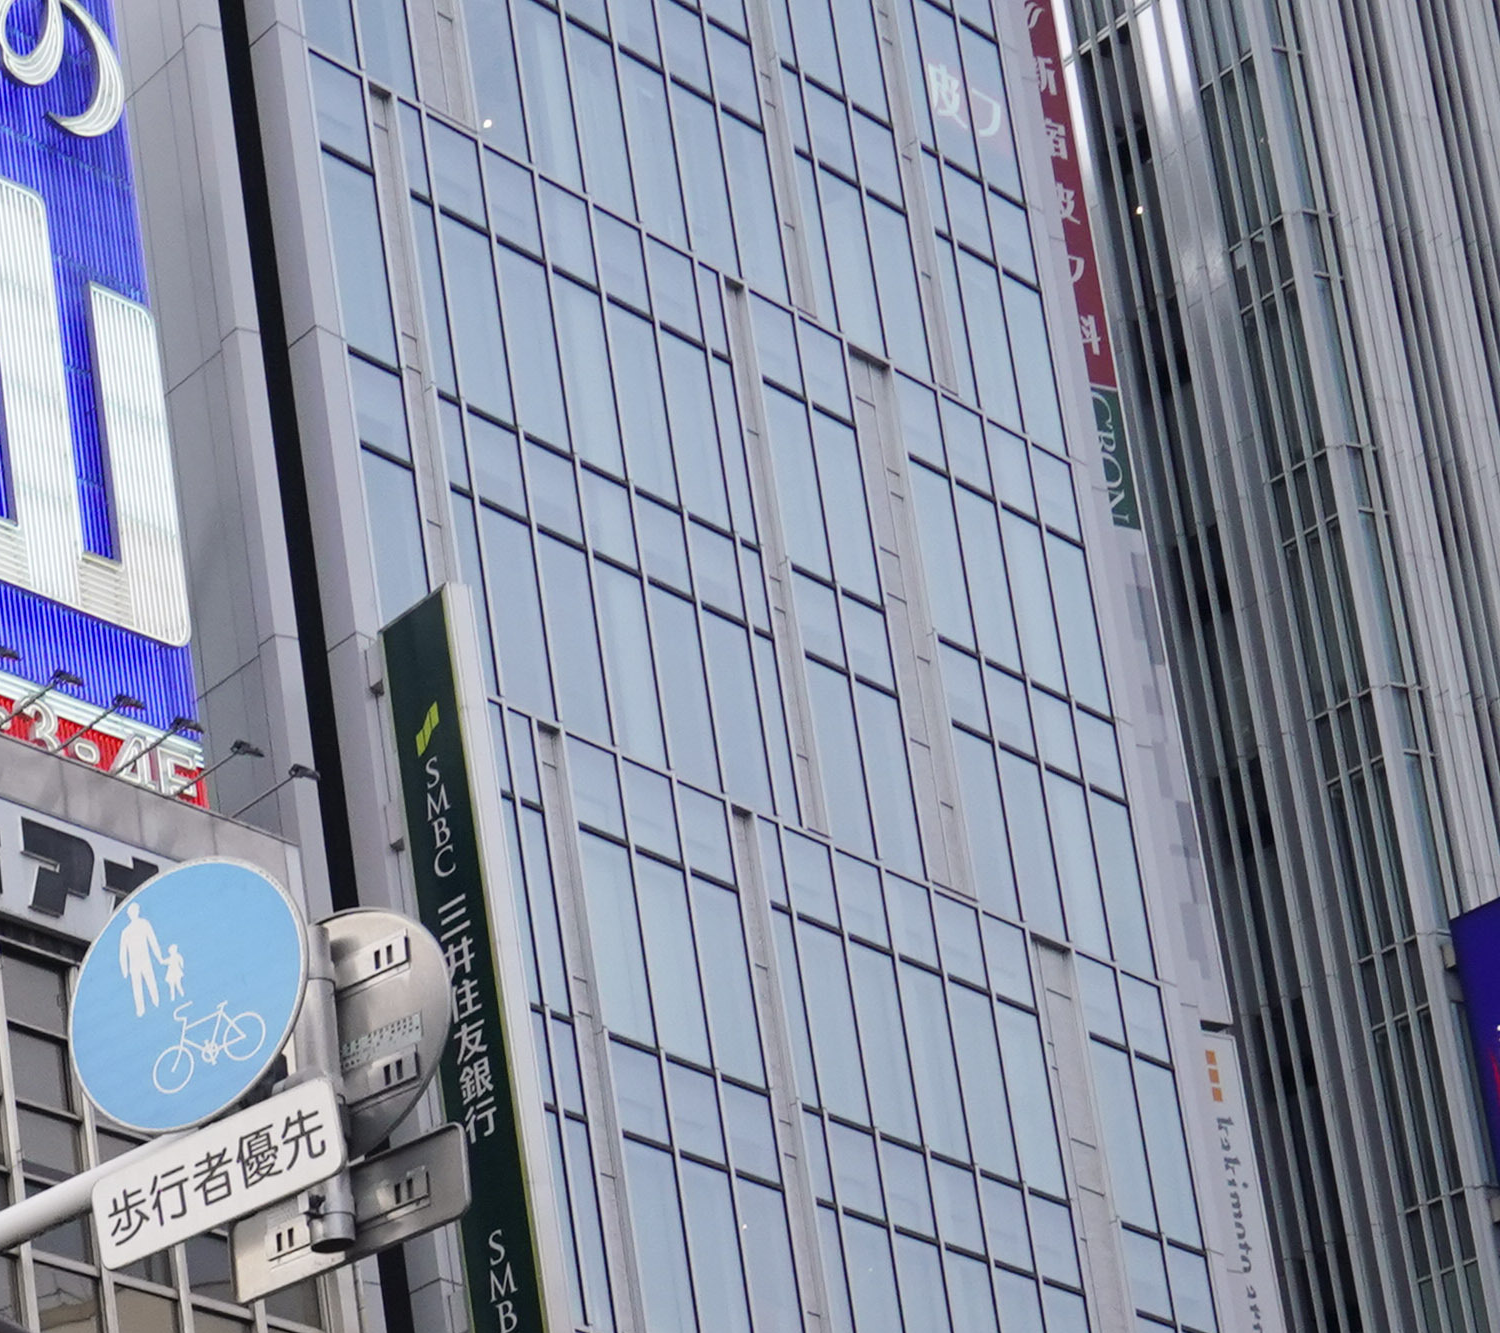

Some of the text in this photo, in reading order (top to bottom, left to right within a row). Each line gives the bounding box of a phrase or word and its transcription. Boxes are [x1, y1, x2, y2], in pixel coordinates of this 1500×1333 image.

[426, 755, 497, 1145] SMBC 三井住友銀行
[107, 1108, 328, 1248] 歩行者優先
